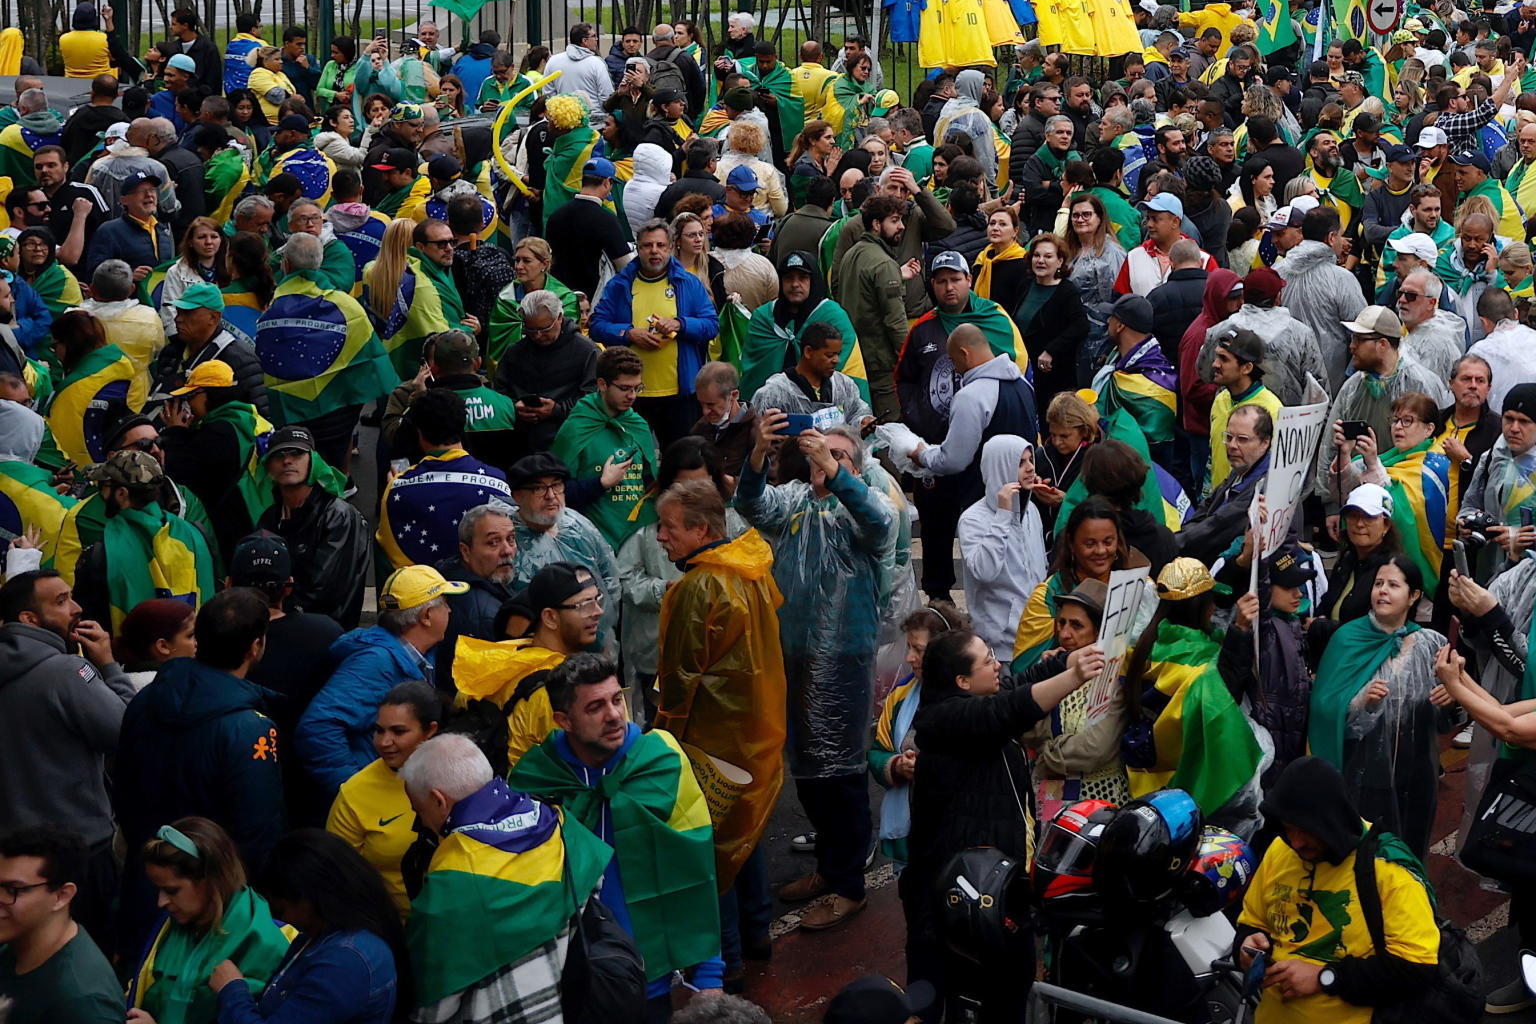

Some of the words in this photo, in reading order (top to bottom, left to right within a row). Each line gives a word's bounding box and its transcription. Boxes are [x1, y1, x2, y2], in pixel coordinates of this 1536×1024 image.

[1109, 7, 1116, 17] 9
[966, 12, 978, 26] 10
[351, 232, 382, 245] PROGRES
[257, 320, 278, 329] RDEM
[295, 320, 347, 333] PROGRESSO
[465, 405, 495, 424] NUM
[444, 473, 451, 481] E
[461, 474, 510, 494] PROGRE
[612, 494, 623, 502] DE
